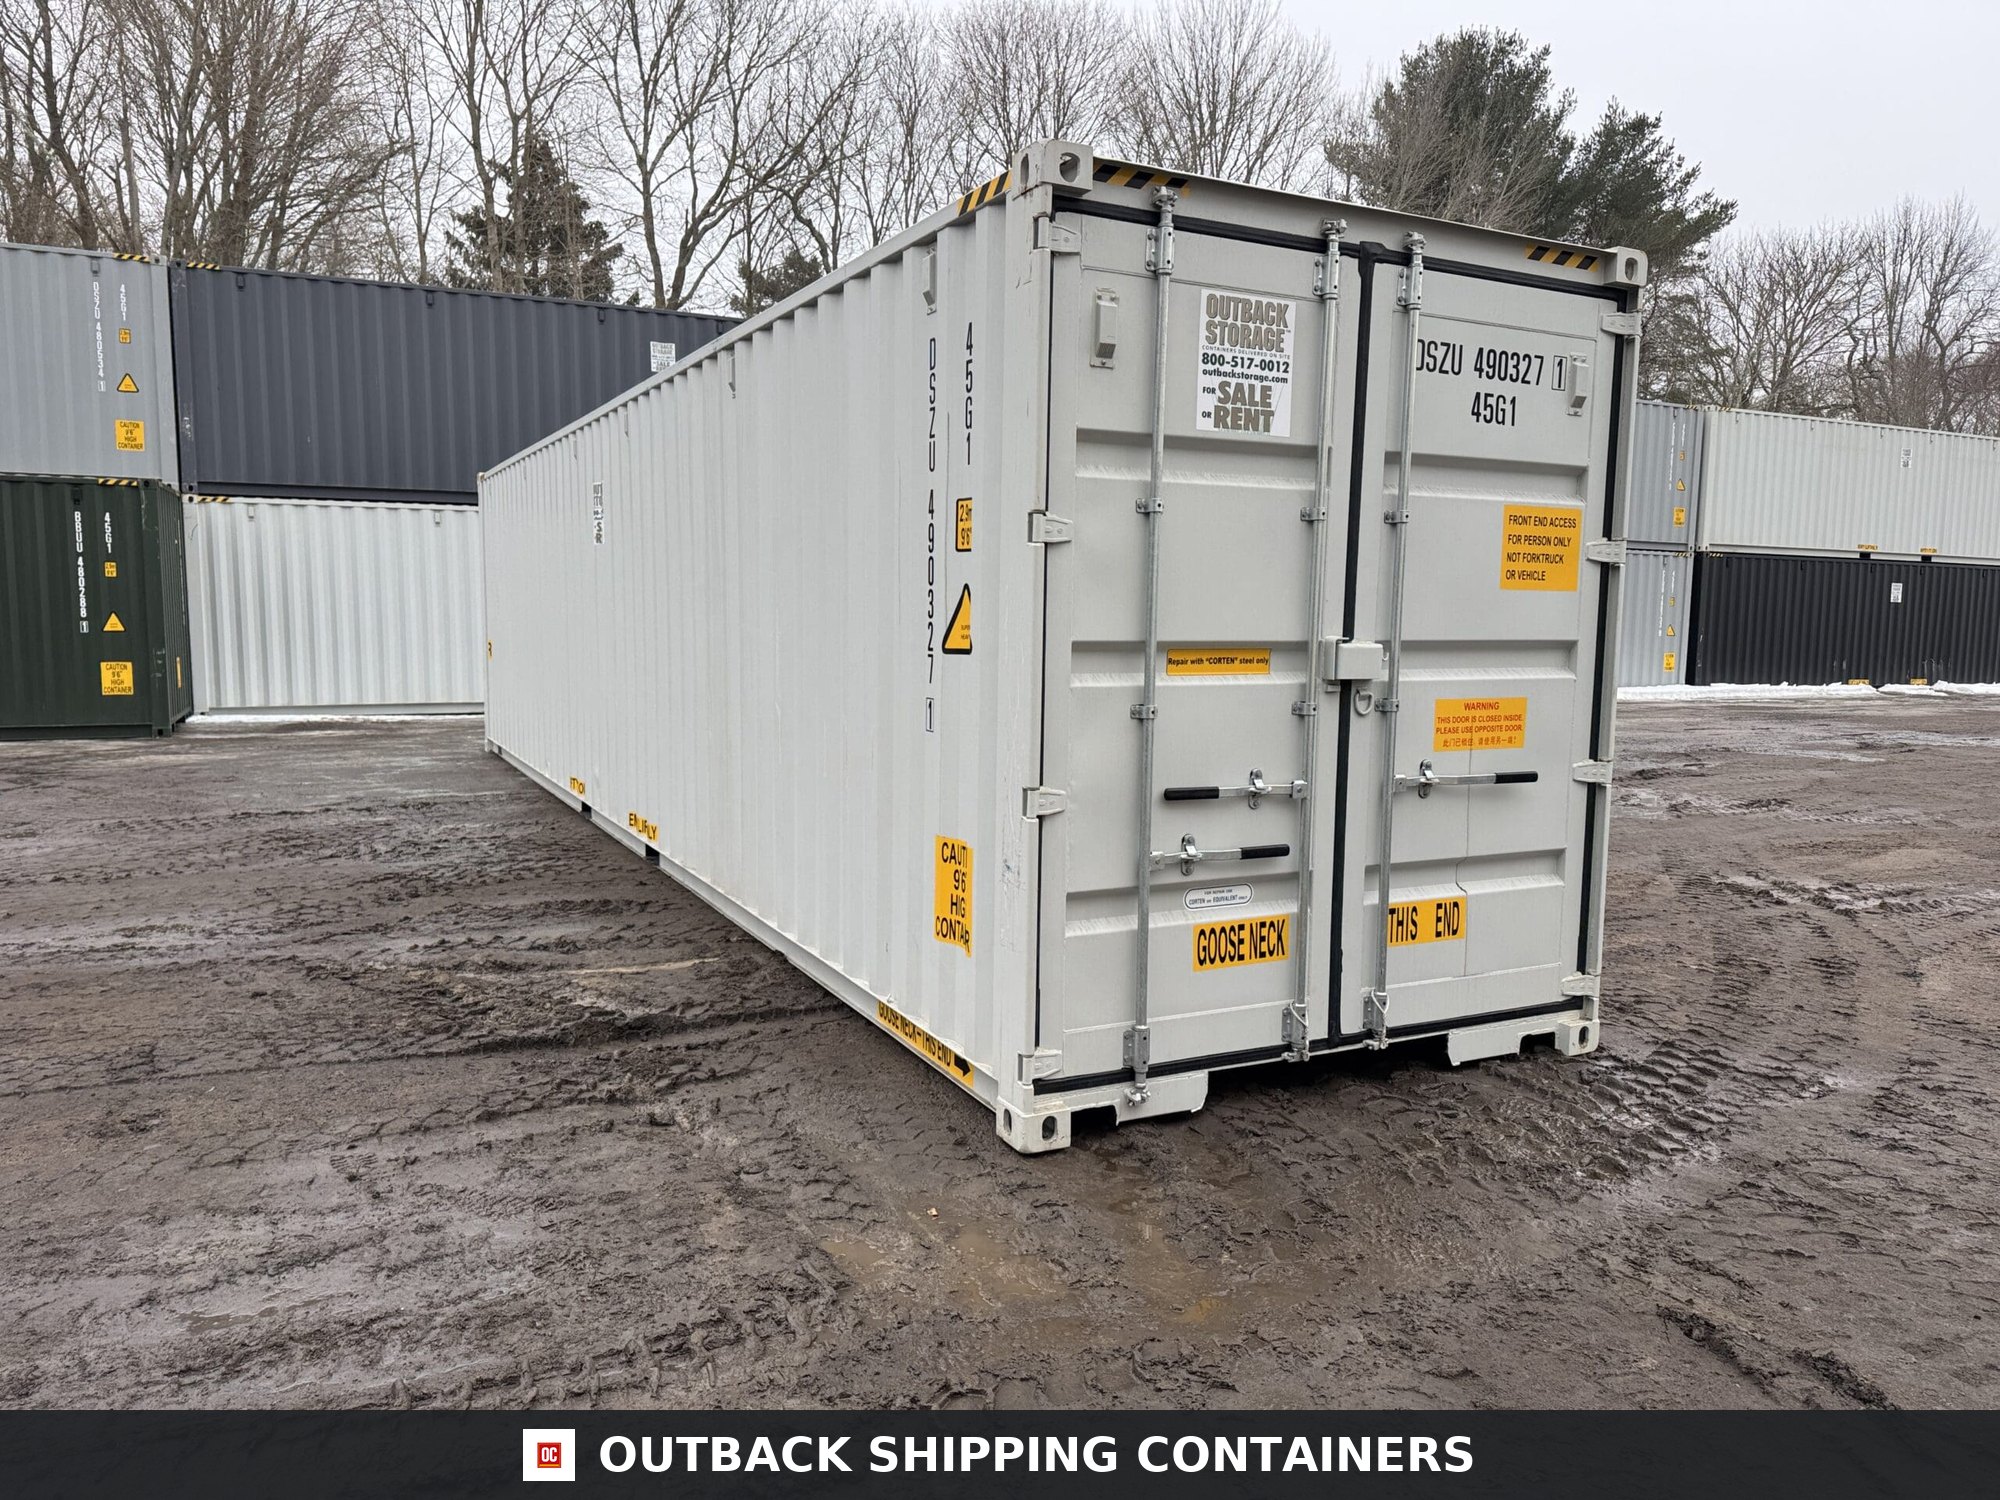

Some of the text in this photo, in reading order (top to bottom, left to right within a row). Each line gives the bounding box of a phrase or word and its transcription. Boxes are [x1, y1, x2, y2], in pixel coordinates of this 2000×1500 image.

[1206, 293, 1289, 328] OUTBACK
[96, 322, 104, 378] 480534
[1206, 320, 1286, 352] STORAGE
[1202, 345, 1236, 353] CONTAINERS
[1238, 349, 1268, 357] DELIVERED
[1202, 352, 1290, 374] 800-517-0012
[1202, 368, 1288, 384] outbackstorage.com
[1474, 347, 1544, 386] 490327
[1202, 380, 1272, 408] FOR SALE
[1202, 404, 1274, 432] OR RENT
[1471, 391, 1517, 426] 45G1
[74, 511, 83, 552] BBUU
[1508, 515, 1576, 528] FRONT END ACCESS
[1508, 534, 1571, 547] FOR PERSON ONLY
[1507, 552, 1564, 564] NOT FORKTRUCK
[78, 556, 86, 618] 480288
[1506, 570, 1546, 580] OR VEHICLE
[1168, 658, 1188, 667] Repair
[1256, 657, 1268, 665] only
[1464, 702, 1500, 711] WARNING
[1389, 901, 1460, 943] THIS END
[1197, 919, 1285, 966] GOOSE NECK
